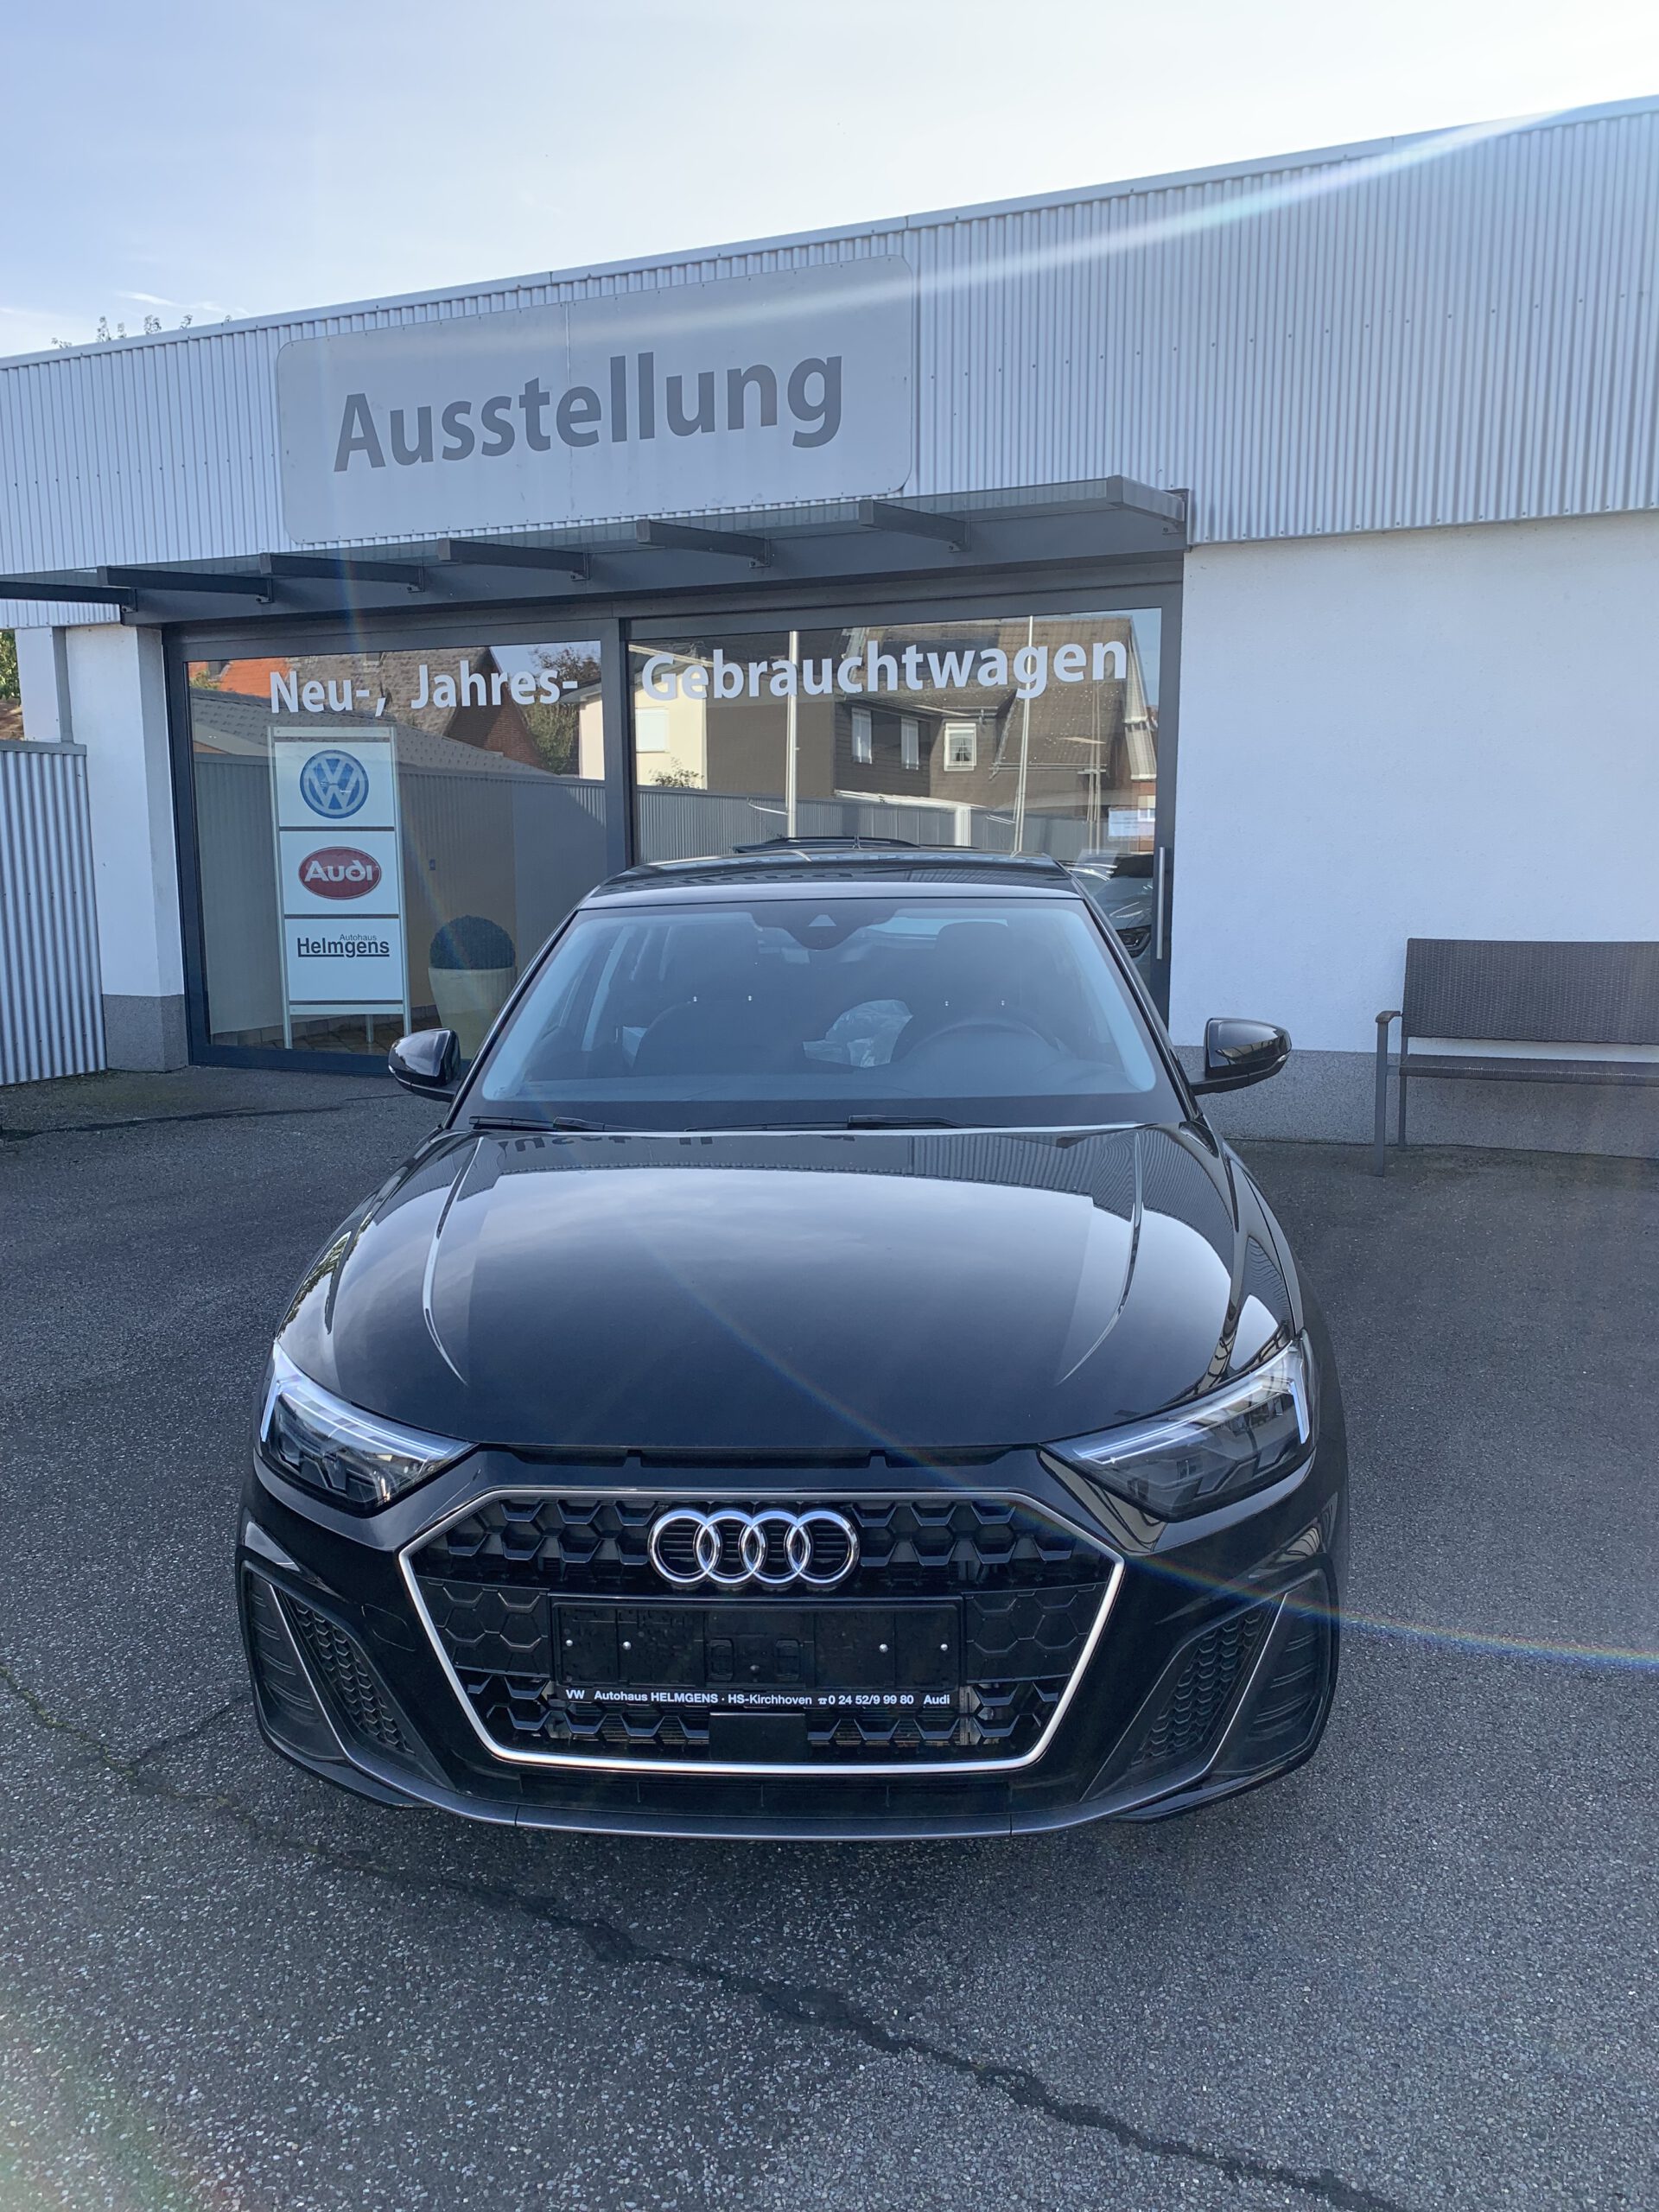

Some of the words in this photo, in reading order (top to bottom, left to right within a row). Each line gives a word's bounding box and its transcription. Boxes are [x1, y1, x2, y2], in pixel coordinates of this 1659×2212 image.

[334, 351, 842, 473] Ausstellung
[270, 670, 386, 716] Neu-,
[410, 659, 578, 709] Jahres-
[641, 639, 1128, 701] Gebrauchtwagen
[303, 859, 373, 882] Audi
[297, 937, 390, 958] Helmgens
[339, 933, 378, 942] Autohaus
[565, 1689, 585, 1700] VW
[594, 1690, 648, 1702] Autohaus
[651, 1692, 718, 1704] HELMGENS
[728, 1694, 812, 1705] HS-Kirchhoven
[838, 1694, 853, 1705] 24
[855, 1694, 880, 1706] 52/9
[883, 1694, 897, 1705] 99
[899, 1694, 914, 1705] 80
[923, 1694, 950, 1705] Audi
